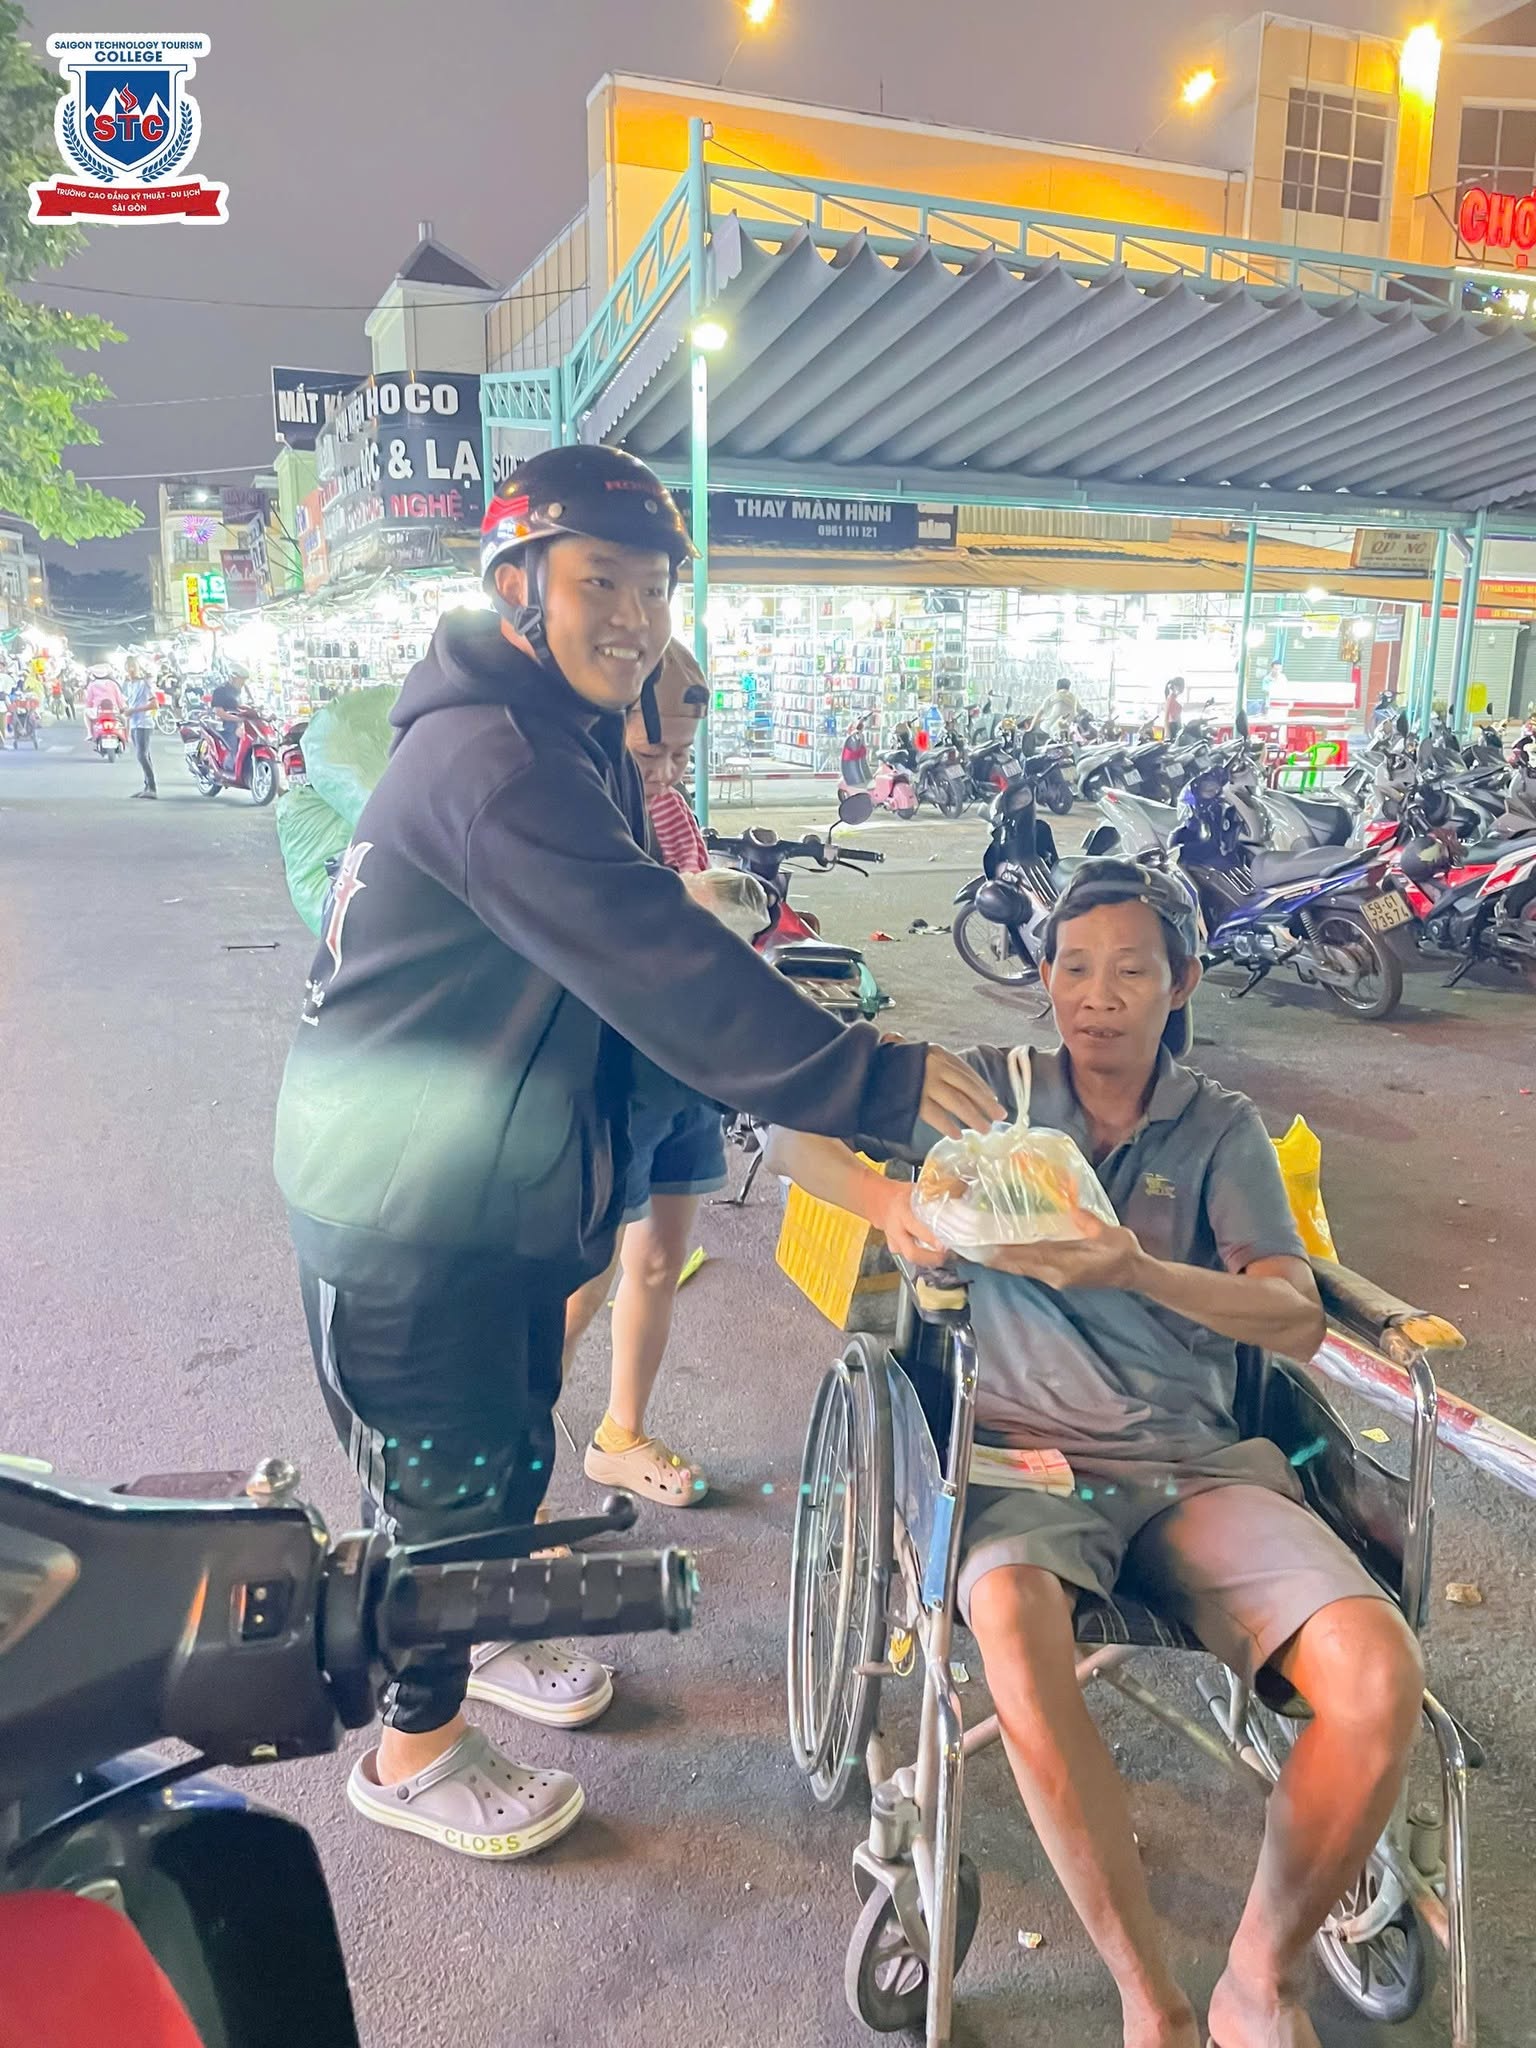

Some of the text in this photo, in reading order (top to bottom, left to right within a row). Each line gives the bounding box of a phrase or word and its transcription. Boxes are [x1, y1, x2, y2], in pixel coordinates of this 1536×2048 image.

[388, 439, 414, 480] &
[425, 439, 482, 488] LẠ
[735, 498, 892, 522] THAY MÀN HÌNH
[445, 1828, 521, 1851] CLOSS
